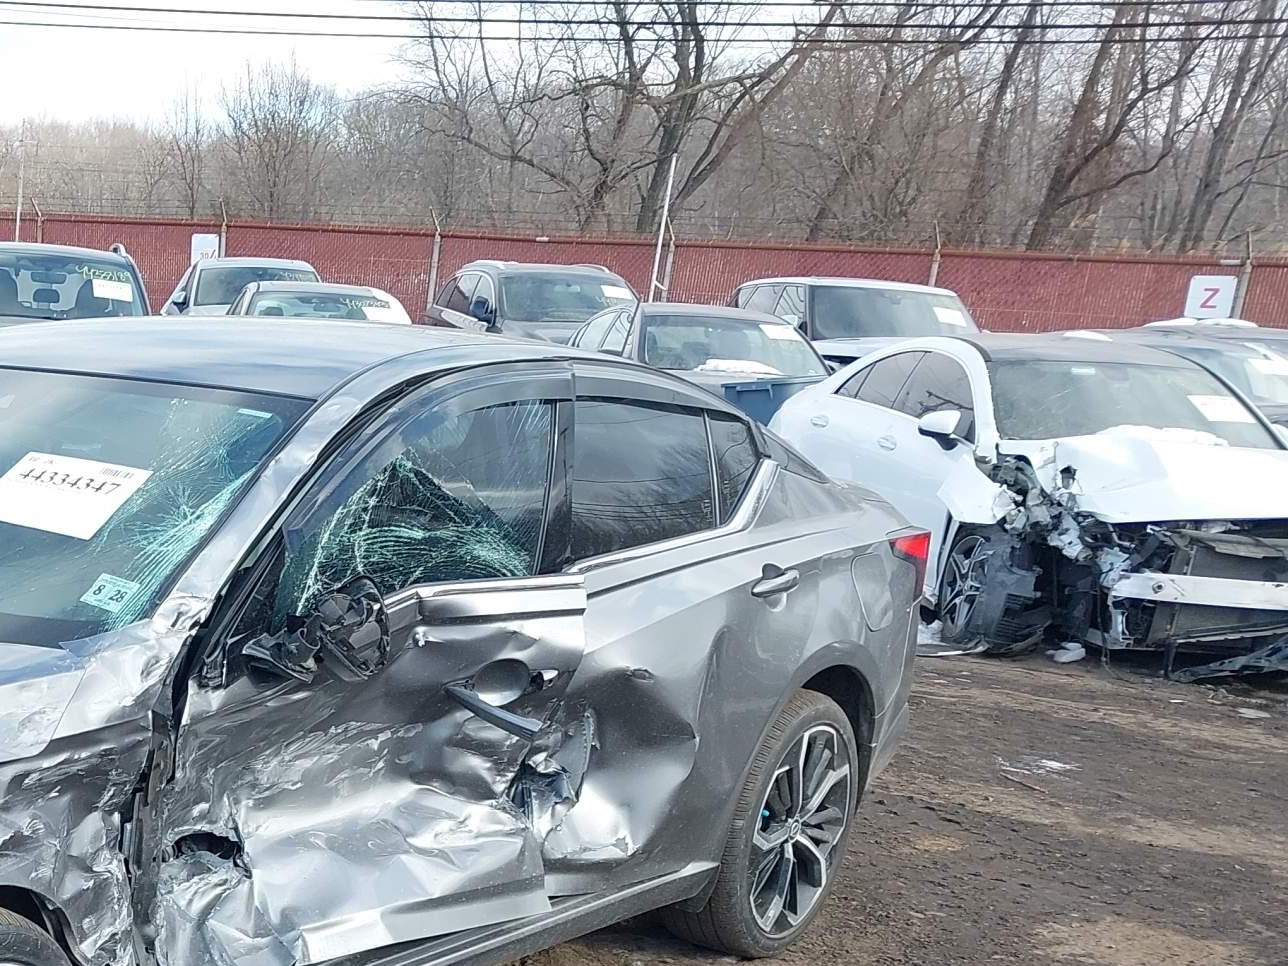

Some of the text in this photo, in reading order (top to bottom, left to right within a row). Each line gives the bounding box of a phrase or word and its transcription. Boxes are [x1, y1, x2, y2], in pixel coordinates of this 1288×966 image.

[1199, 288, 1220, 309] Z
[19, 467, 122, 495] 44334347
[93, 584, 106, 596] 8
[108, 589, 128, 603] 28
